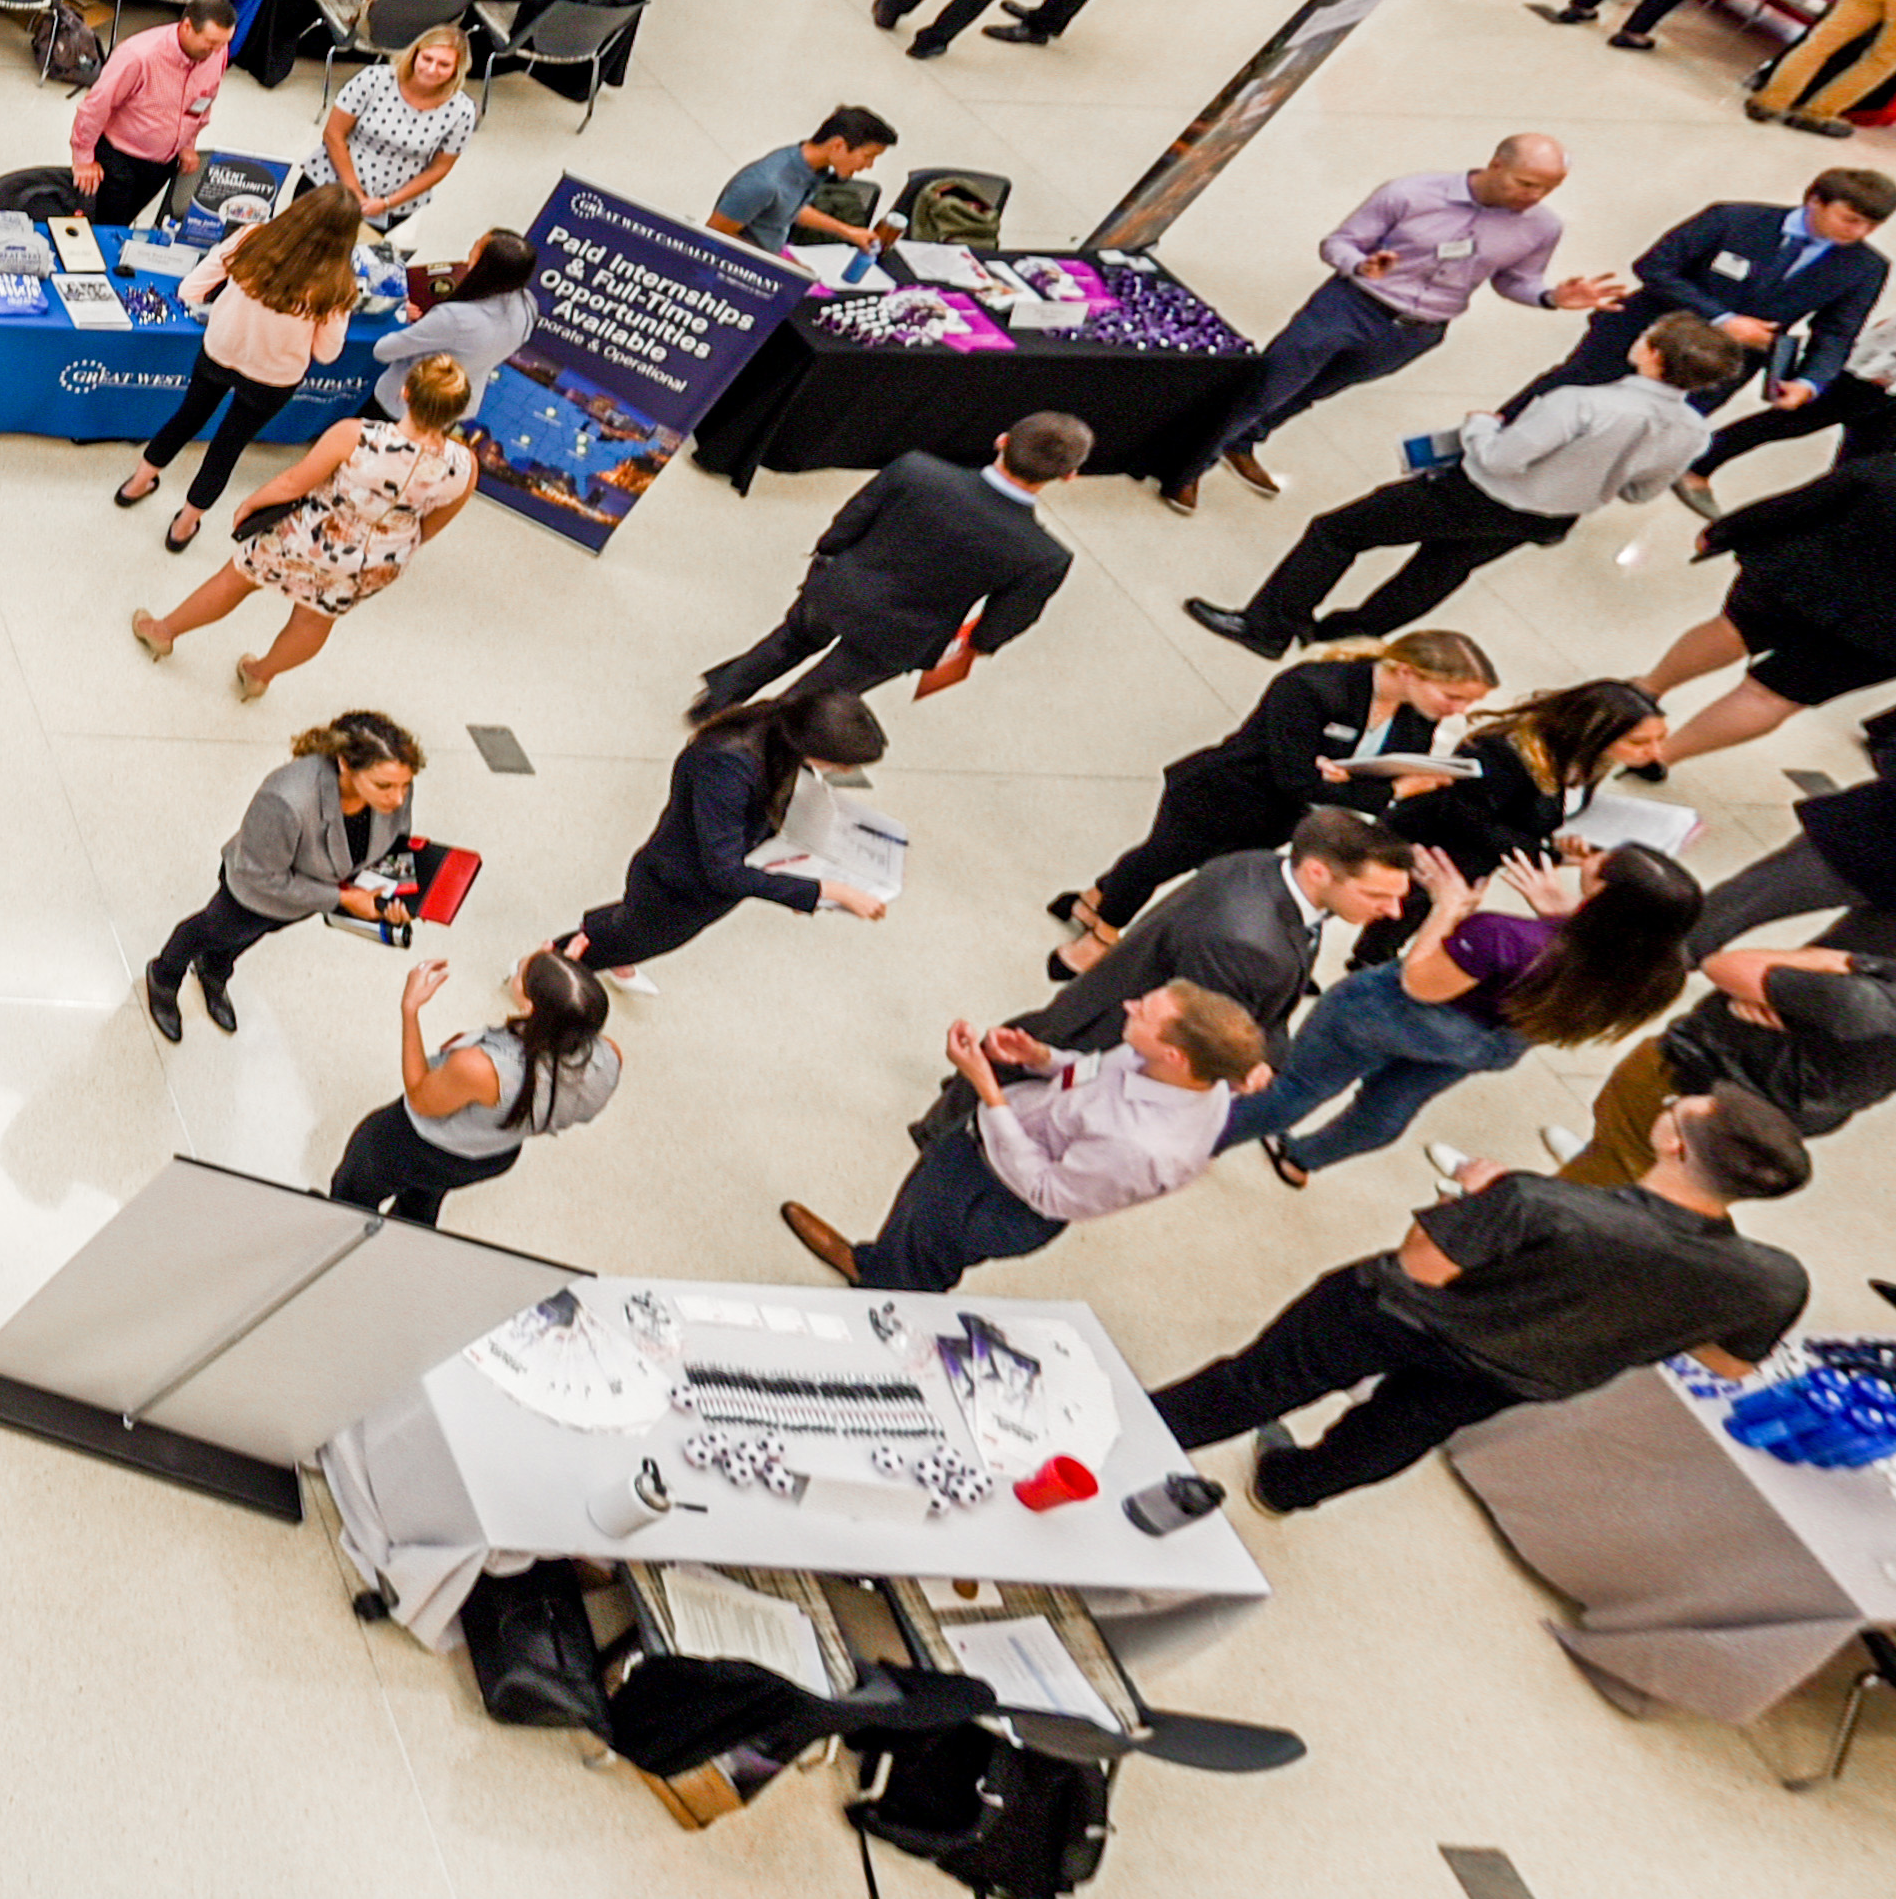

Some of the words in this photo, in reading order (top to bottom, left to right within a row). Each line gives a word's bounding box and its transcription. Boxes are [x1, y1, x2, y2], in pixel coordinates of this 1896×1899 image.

[207, 166, 247, 180] TALENT
[209, 175, 275, 194] COMMUNITY
[546, 224, 608, 266] Paid
[609, 252, 756, 332] Internships
[621, 216, 656, 239] WEST
[655, 231, 720, 266] CASUALTY
[719, 258, 781, 292] COMPANY
[539, 268, 711, 360] Opportunities
[552, 299, 668, 363] Available
[564, 257, 586, 281] &
[591, 268, 709, 335] Full-Time
[72, 370, 133, 385] GREAT
[136, 372, 187, 386] WEST
[536, 315, 585, 345] porate
[587, 337, 600, 352] &
[603, 344, 689, 394] Operational
